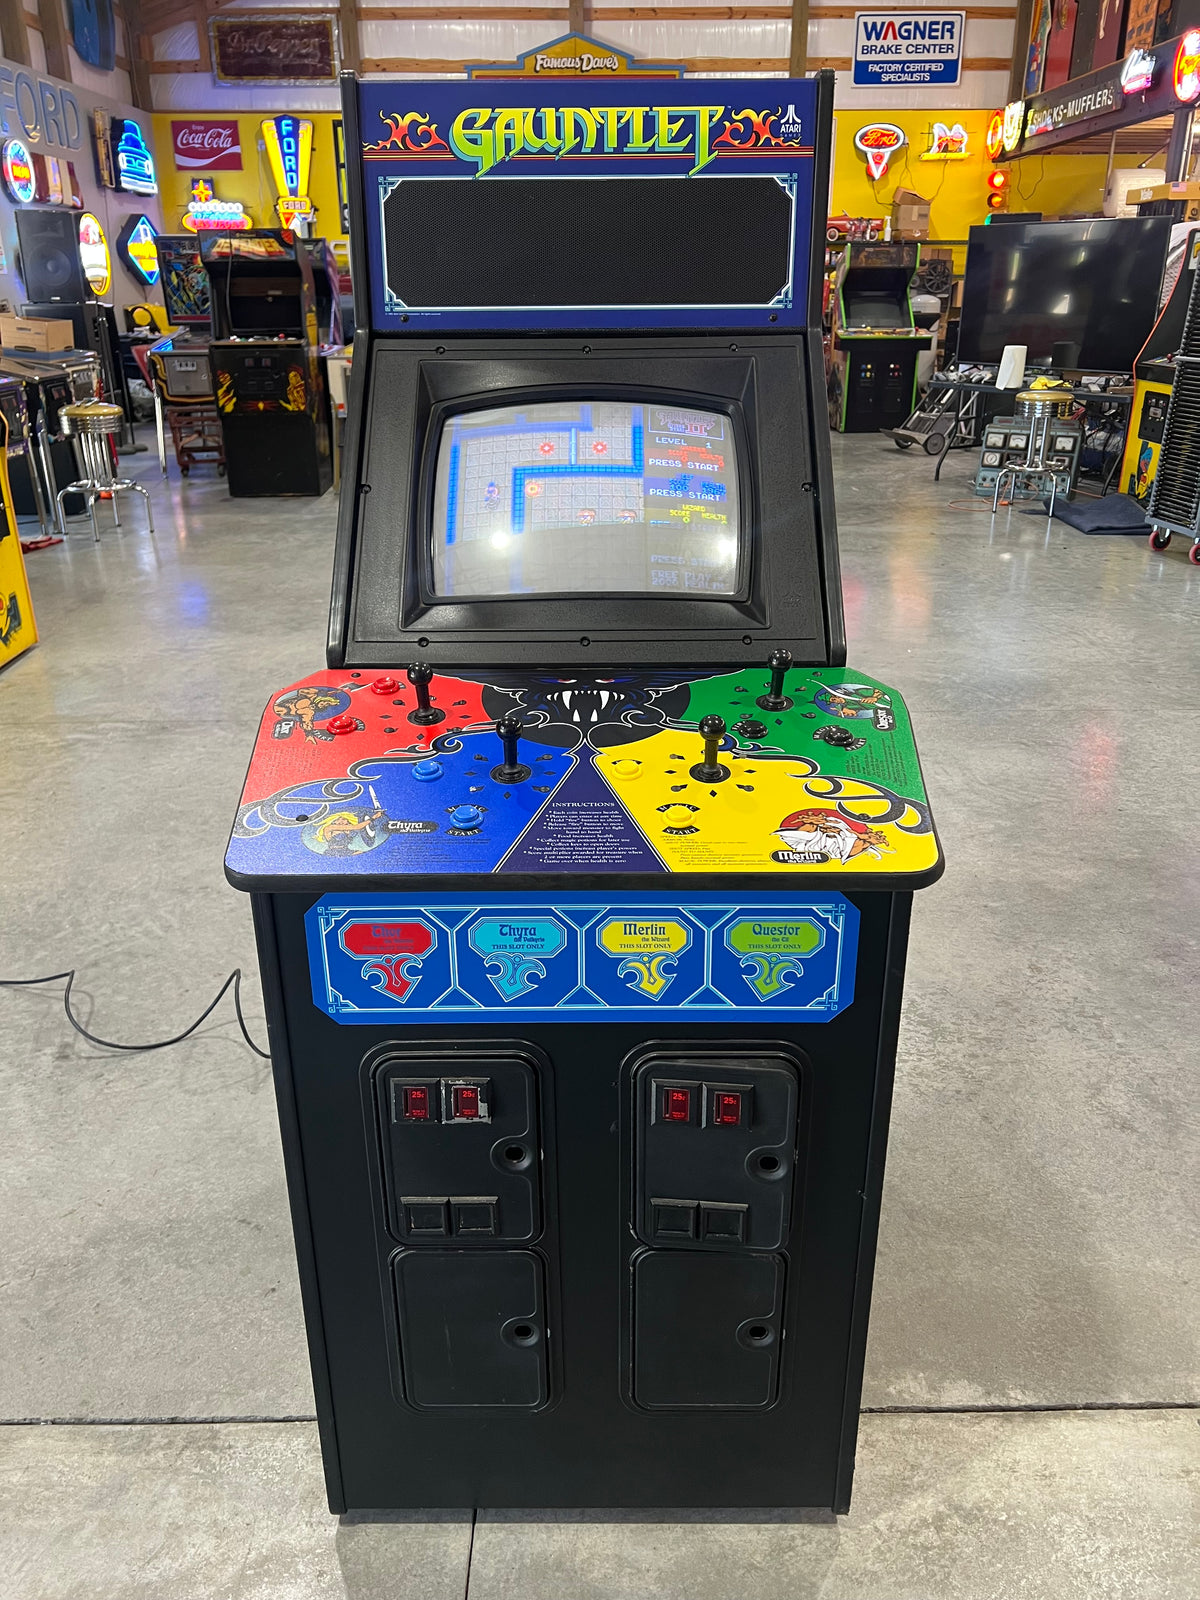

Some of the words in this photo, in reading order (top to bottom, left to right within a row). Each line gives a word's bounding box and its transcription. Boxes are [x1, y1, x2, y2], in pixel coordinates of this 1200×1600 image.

[863, 20, 955, 41] WAGNER
[861, 44, 902, 55] BRAKE
[905, 43, 955, 54] CENTER
[534, 53, 581, 72] Famous
[580, 52, 619, 72] Dave's
[868, 63, 903, 73] FACTORY
[904, 62, 944, 72] CERTIFIED
[881, 73, 931, 82] SPECIALISTS
[0, 63, 82, 151] FORD
[780, 123, 802, 133] ATARI
[176, 127, 233, 149] Coca-Cola
[449, 104, 725, 178] GAUNTLET
[861, 127, 899, 148] Ford
[281, 119, 298, 188] FORD
[655, 436, 688, 446] LEVEL
[648, 458, 682, 468] PRESS
[687, 461, 719, 472] START
[649, 488, 683, 498] PRESS
[688, 491, 721, 502] START
[388, 820, 423, 832] Thyra
[665, 828, 697, 836] START
[777, 851, 822, 861] Merlin
[499, 924, 537, 939] Thyra
[623, 923, 666, 936] Merlin
[752, 923, 801, 936] Questor
